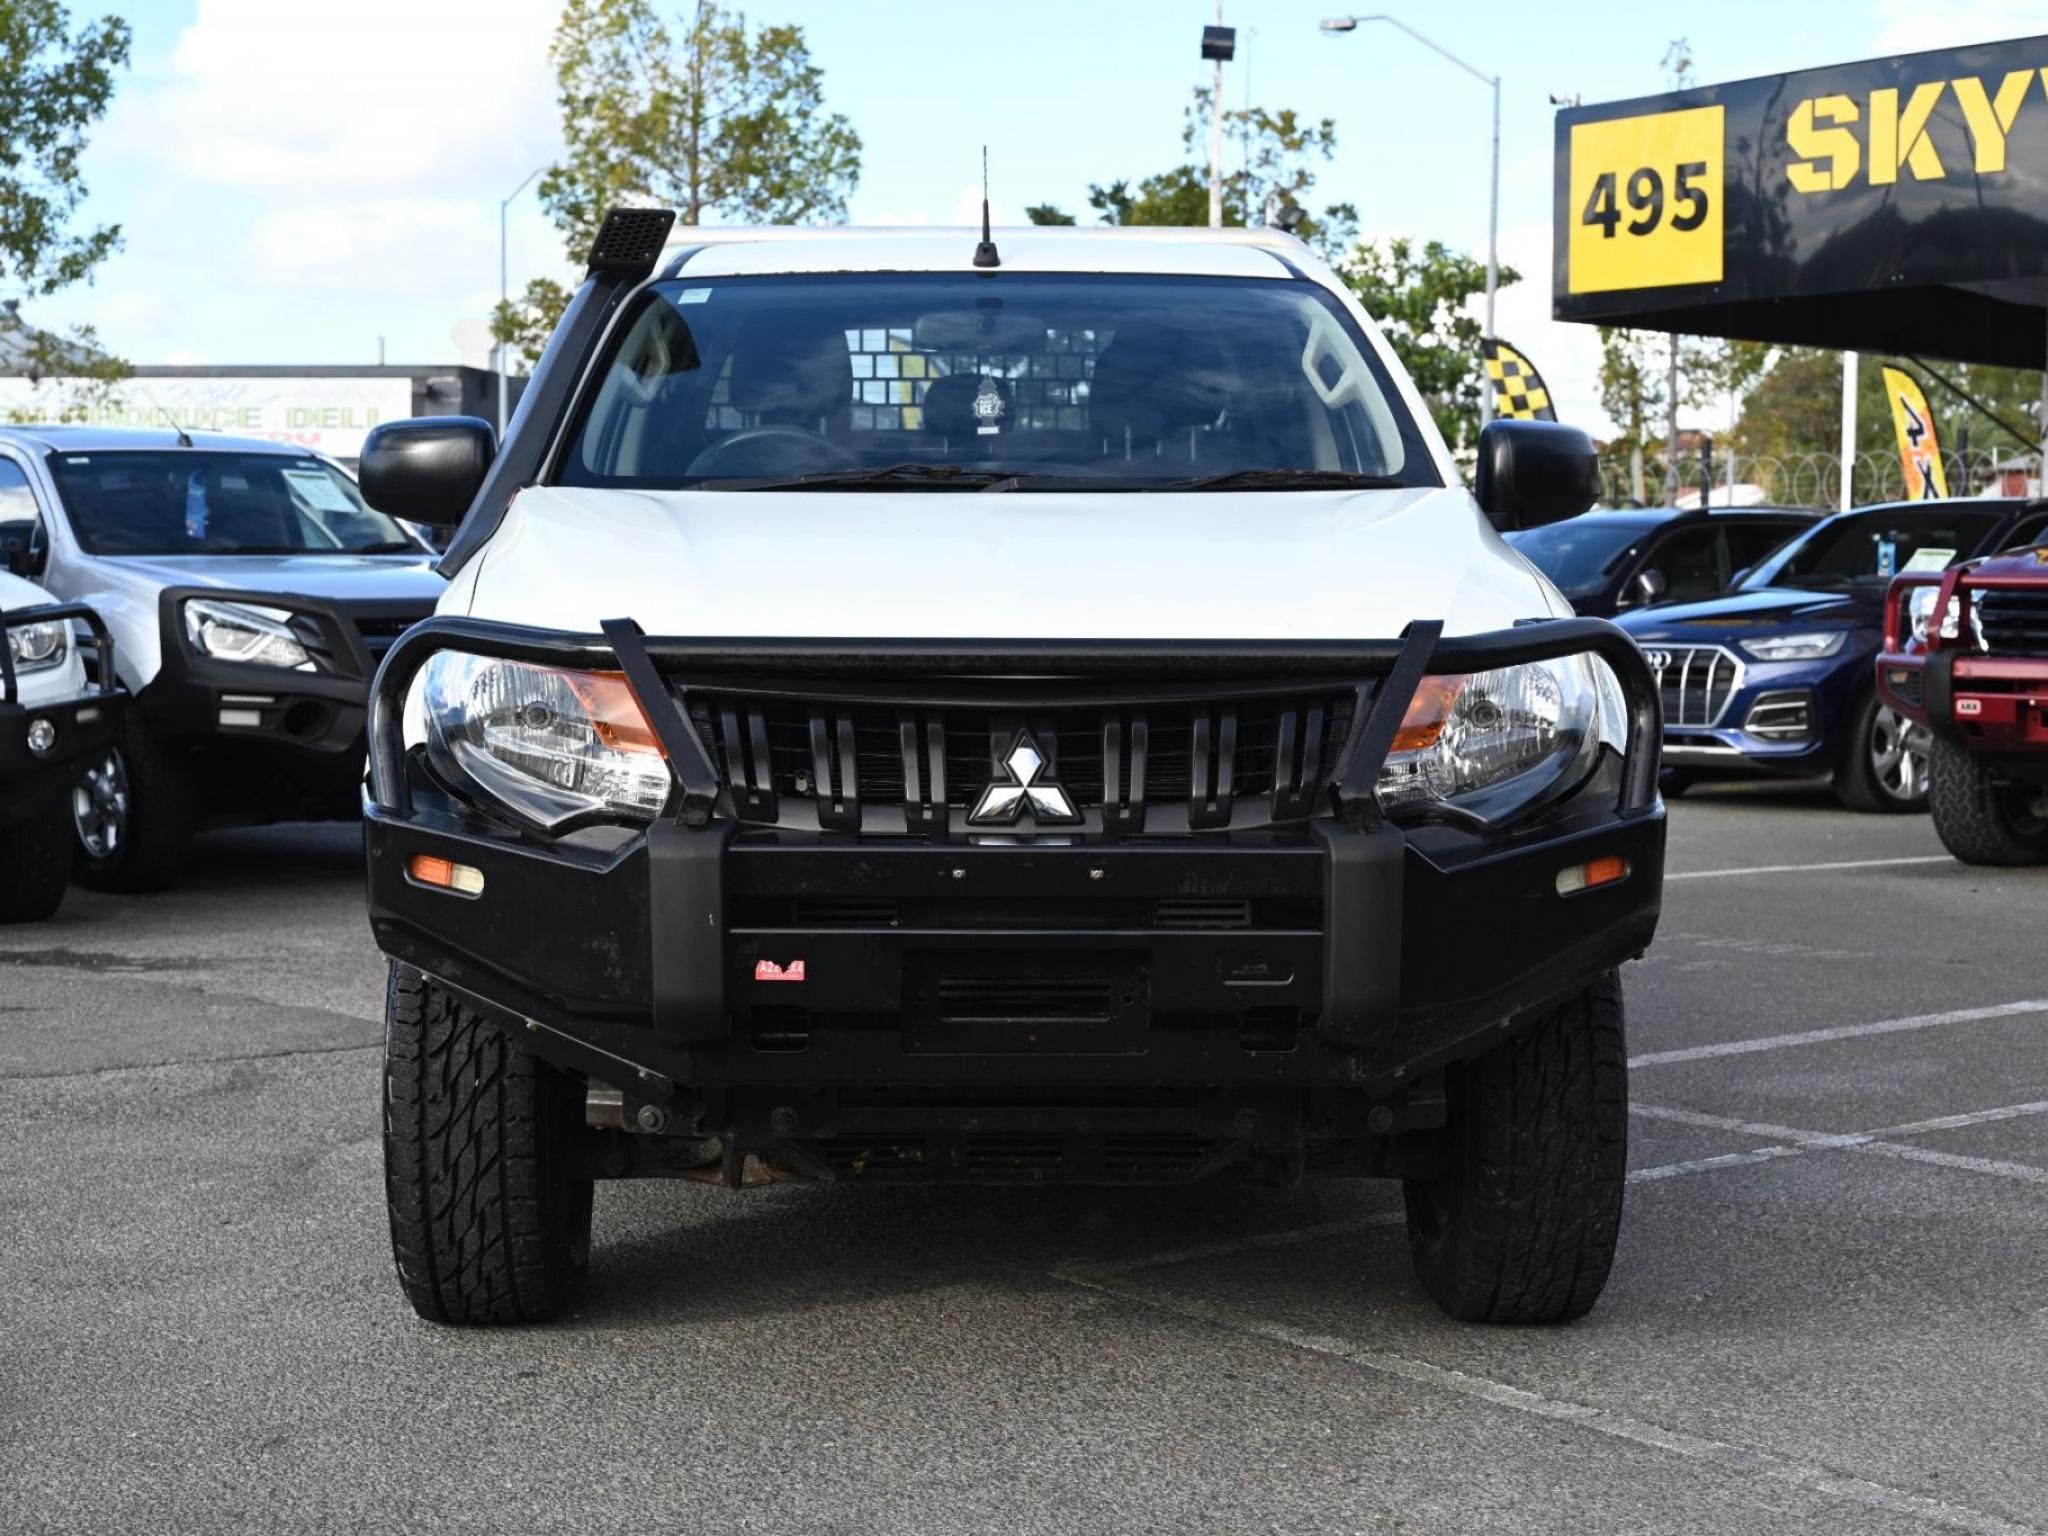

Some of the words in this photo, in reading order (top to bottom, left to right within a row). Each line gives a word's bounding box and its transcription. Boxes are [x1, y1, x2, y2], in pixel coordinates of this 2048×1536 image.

[1786, 67, 2048, 194] SKY
[1582, 161, 1709, 239] 495
[286, 407, 379, 429] DELI
